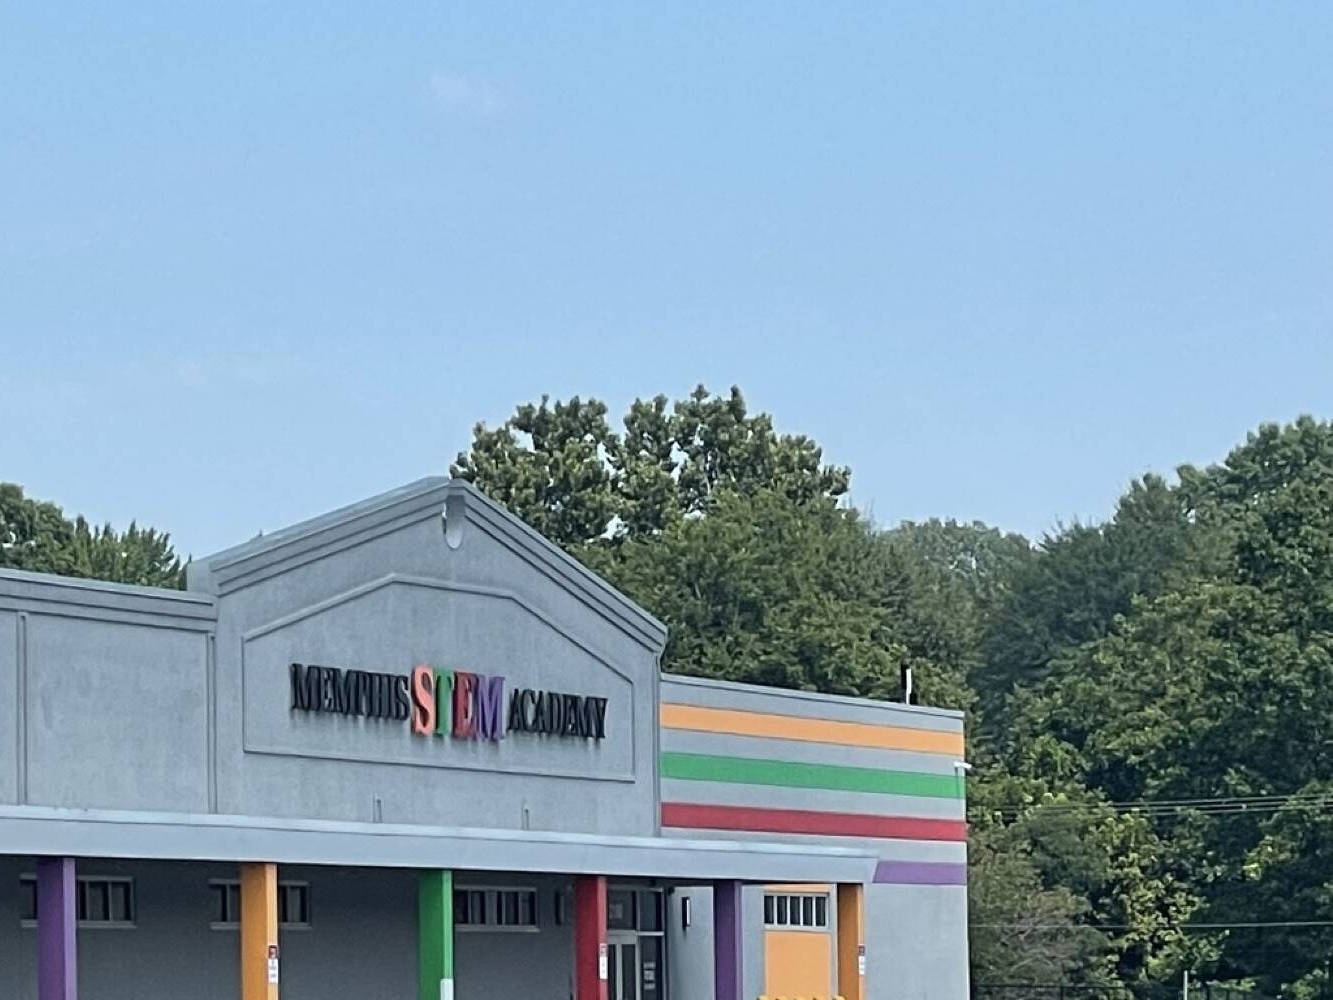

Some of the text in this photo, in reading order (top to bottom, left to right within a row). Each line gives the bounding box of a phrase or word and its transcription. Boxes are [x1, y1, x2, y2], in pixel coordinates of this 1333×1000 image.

[290, 663, 608, 739] MEMPHIS STEM ACADEMY
